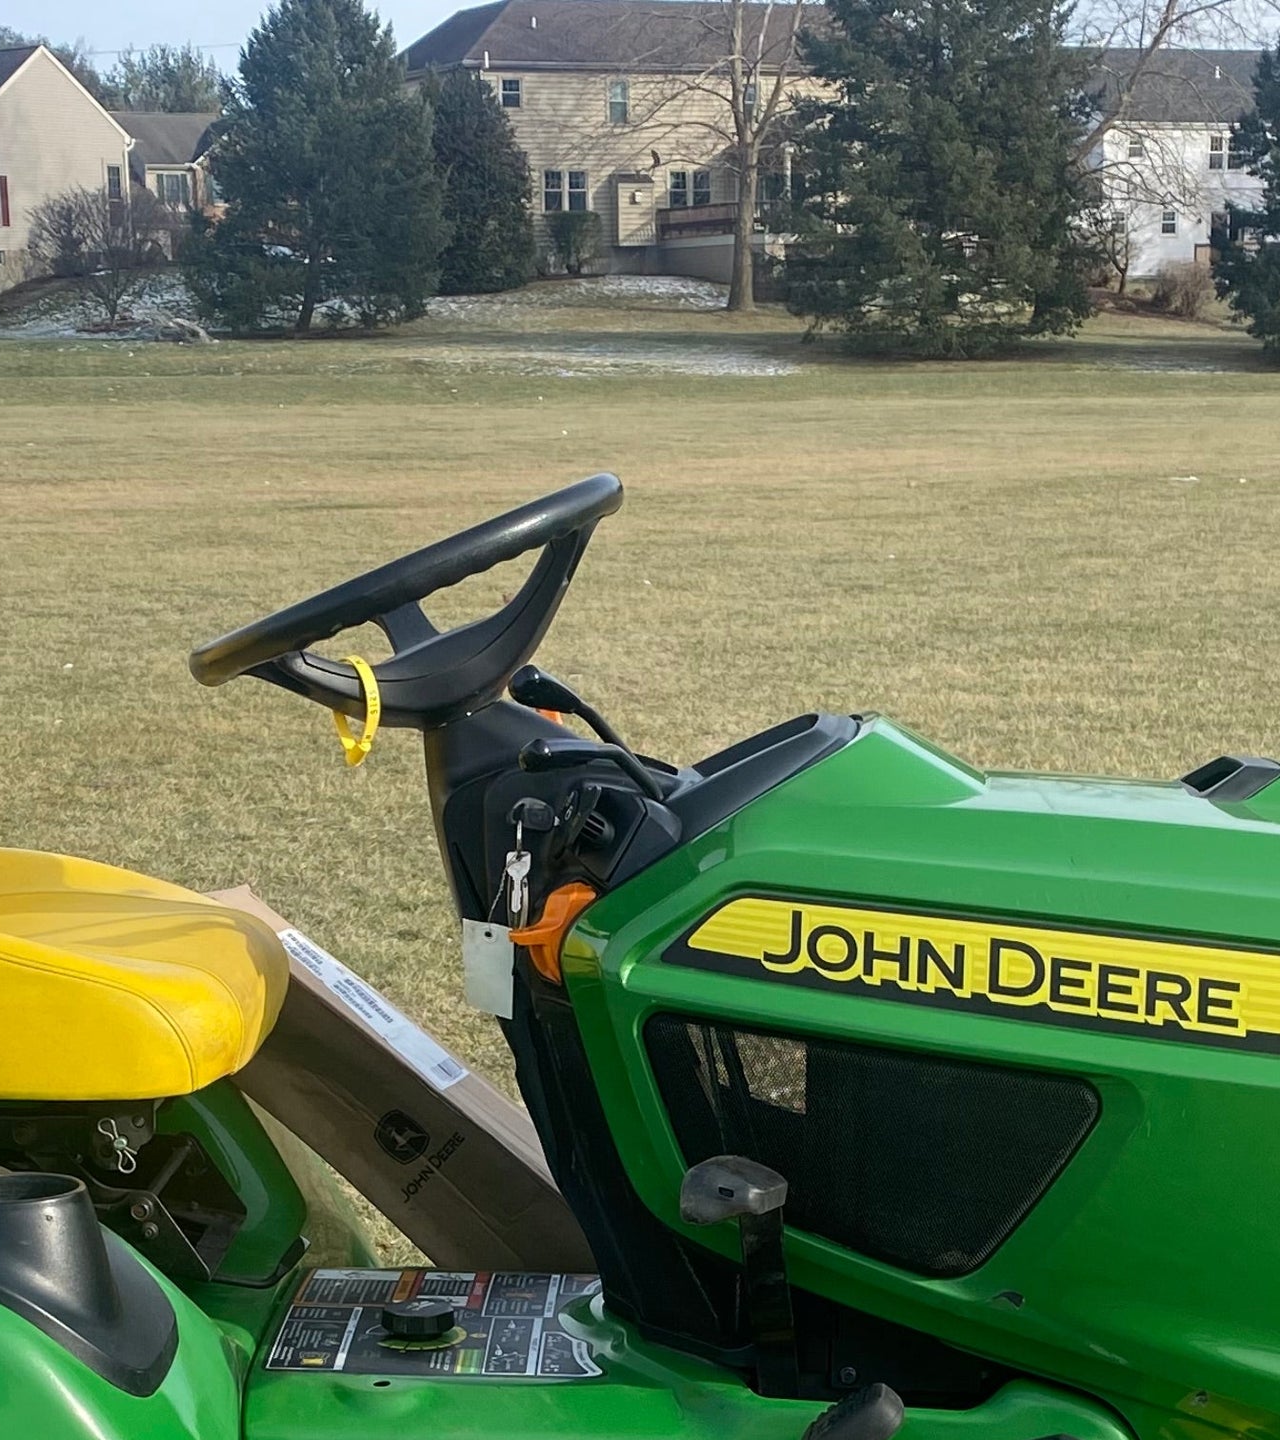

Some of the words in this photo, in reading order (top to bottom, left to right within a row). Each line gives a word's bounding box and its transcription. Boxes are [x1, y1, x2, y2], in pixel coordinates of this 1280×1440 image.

[763, 909, 966, 991] JOHN
[987, 936, 1243, 1029] DEERE
[401, 1164, 435, 1203] JOHN
[427, 1131, 465, 1170] DEERE
